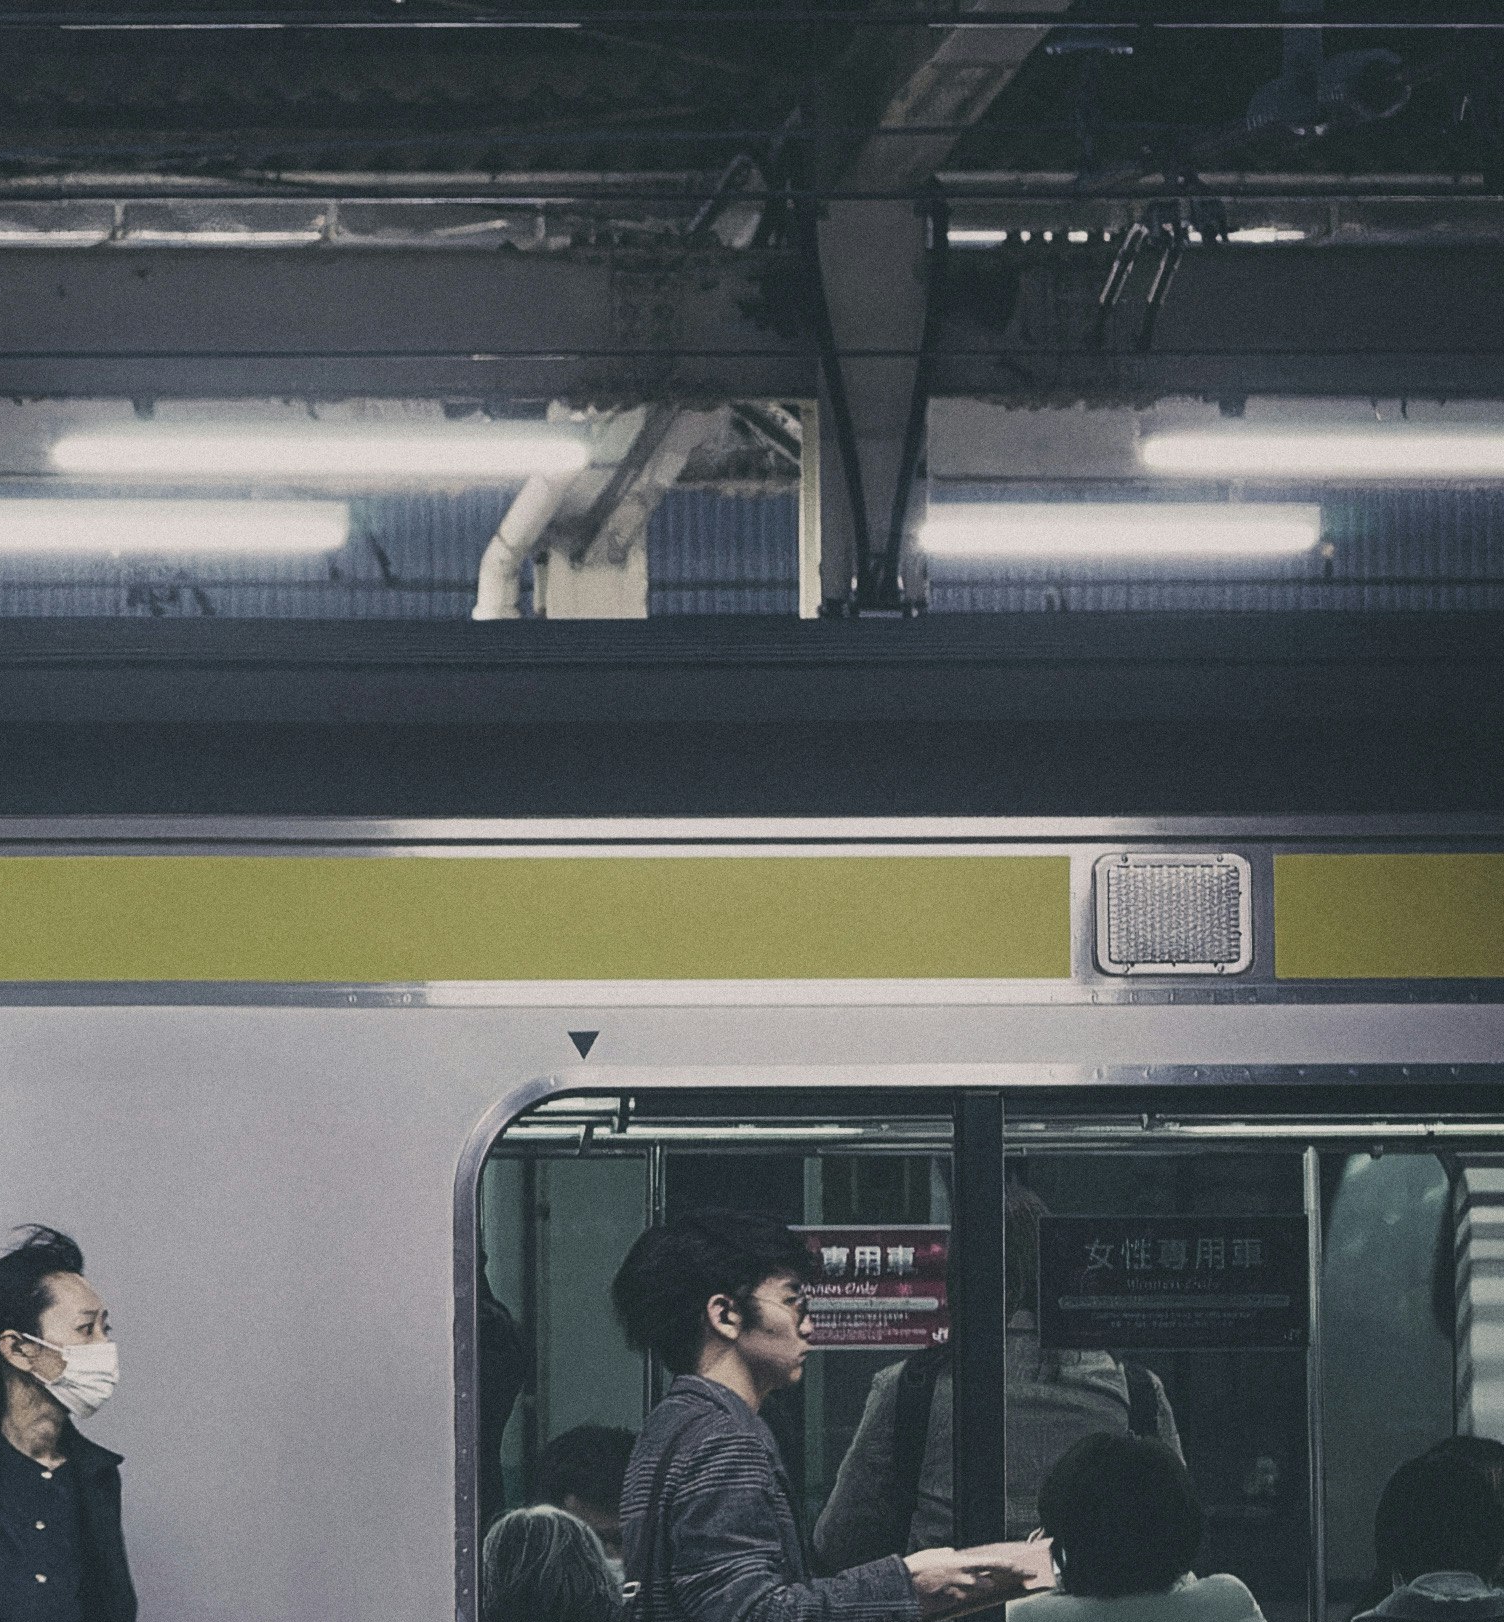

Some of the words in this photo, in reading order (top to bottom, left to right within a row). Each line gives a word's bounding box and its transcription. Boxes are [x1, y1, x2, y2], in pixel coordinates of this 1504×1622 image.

[1083, 1237, 1264, 1271] 女性専用車
